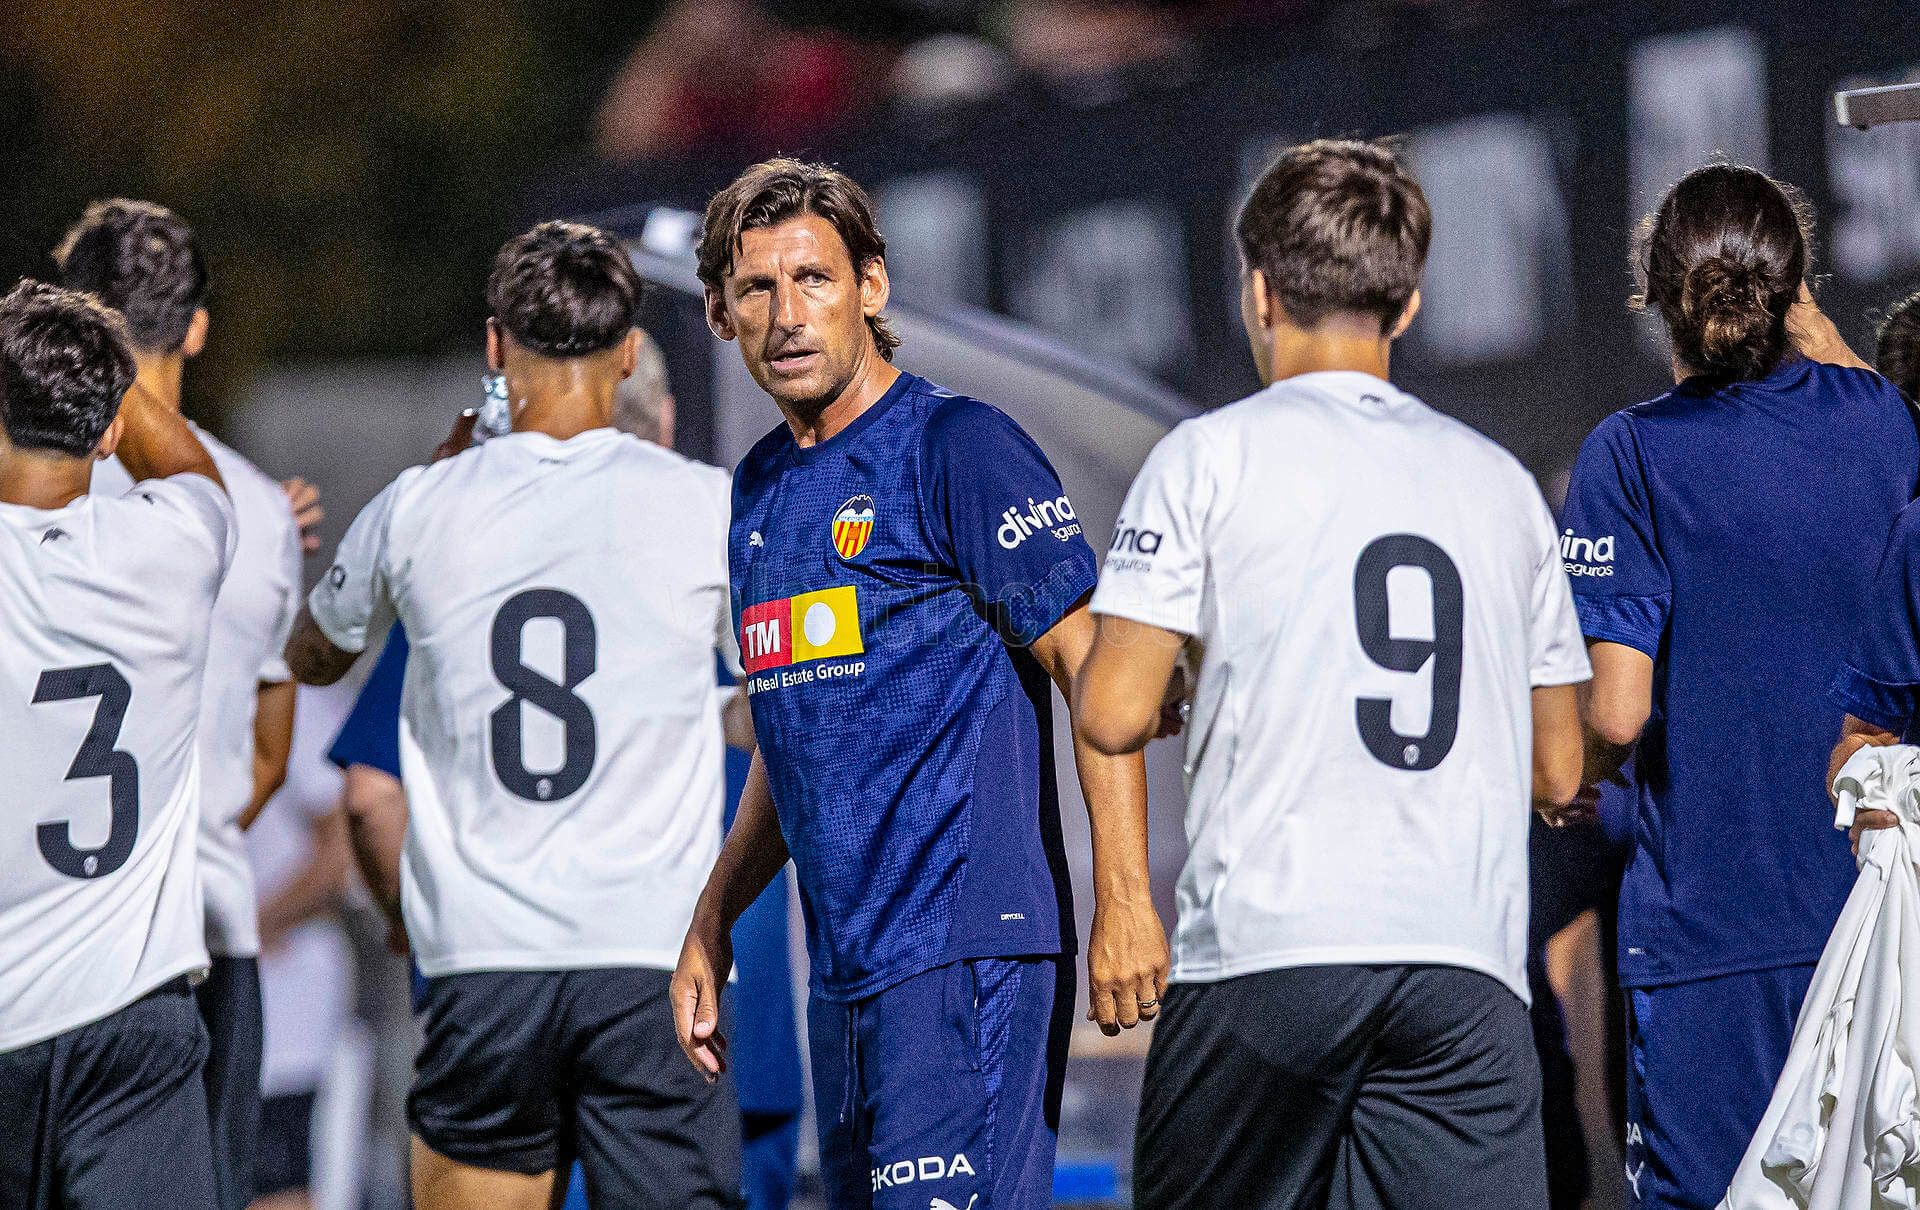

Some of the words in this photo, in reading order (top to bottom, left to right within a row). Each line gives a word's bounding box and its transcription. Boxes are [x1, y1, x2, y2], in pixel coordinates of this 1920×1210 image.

[997, 496, 1076, 549] divina
[1110, 518, 1163, 555] ina
[1560, 528, 1615, 562] ina
[1105, 559, 1152, 573] eguros
[1563, 562, 1614, 577] eguros
[745, 618, 781, 659] TM
[1354, 534, 1464, 771] 9
[490, 588, 597, 803] 8
[757, 673, 779, 692] Real
[782, 669, 814, 688] Estate
[816, 662, 865, 680] Group
[32, 662, 140, 880] 3
